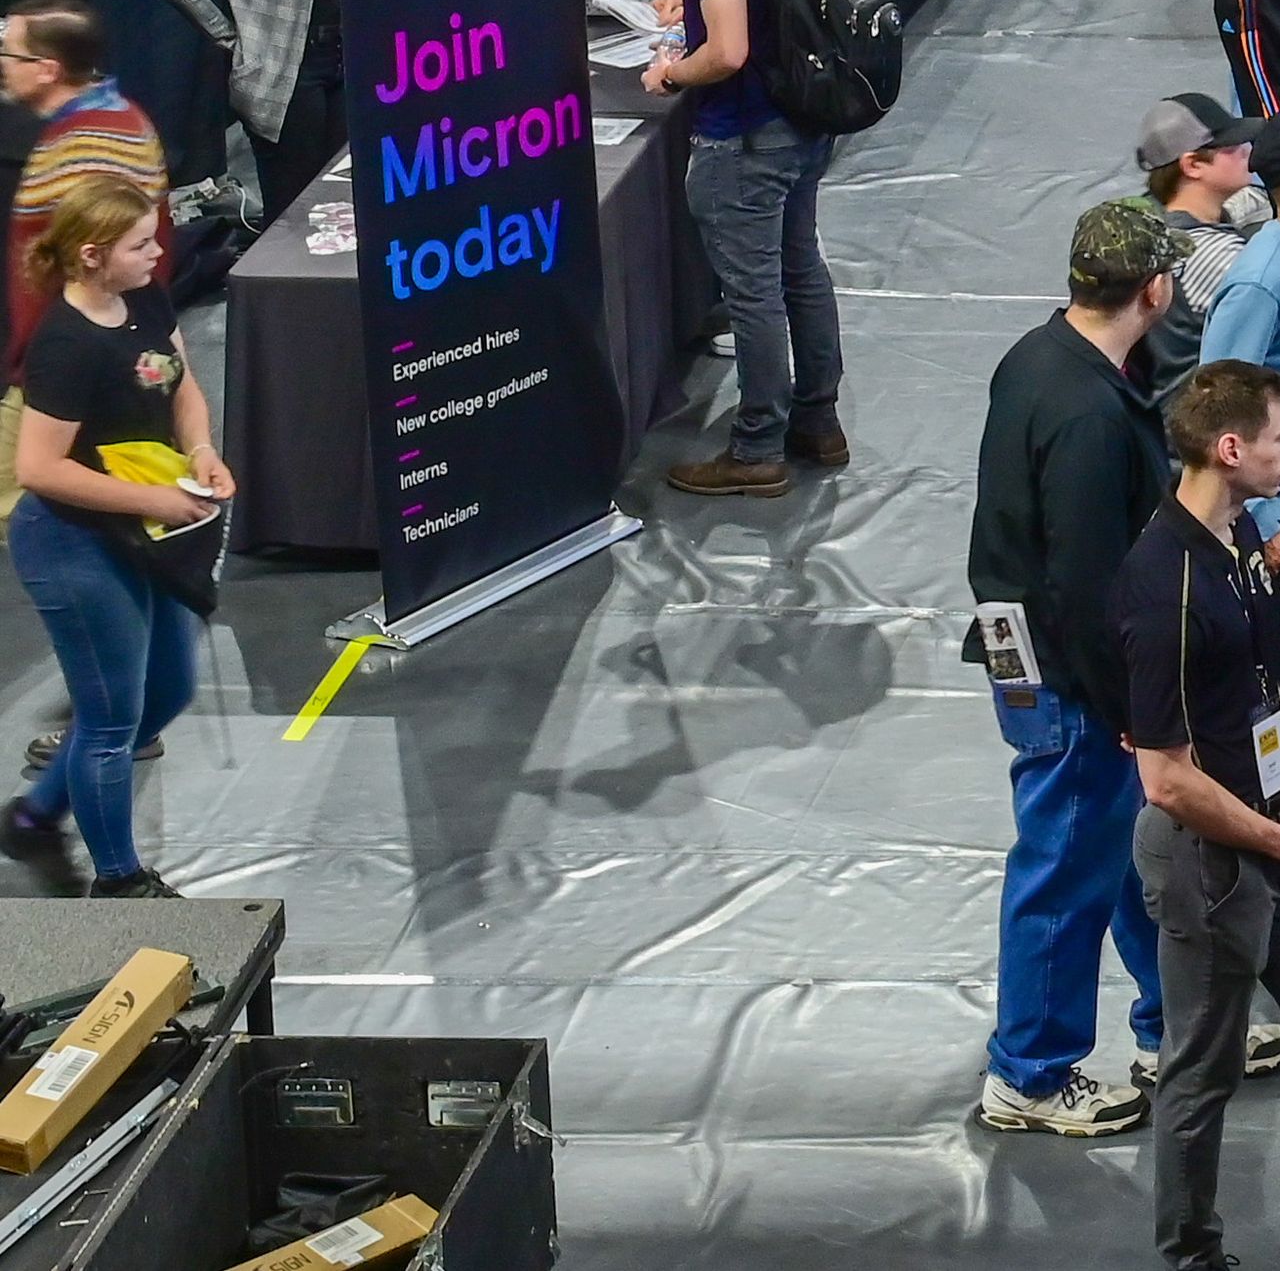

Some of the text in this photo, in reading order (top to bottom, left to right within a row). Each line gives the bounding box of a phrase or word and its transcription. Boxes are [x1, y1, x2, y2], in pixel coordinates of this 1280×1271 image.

[375, 12, 505, 104] Join
[380, 92, 582, 205] Micron
[385, 198, 561, 300] today
[393, 328, 520, 381] Experienced hires
[396, 367, 549, 436] New college graduates
[400, 461, 448, 491] Interns
[403, 502, 480, 544] Technicians
